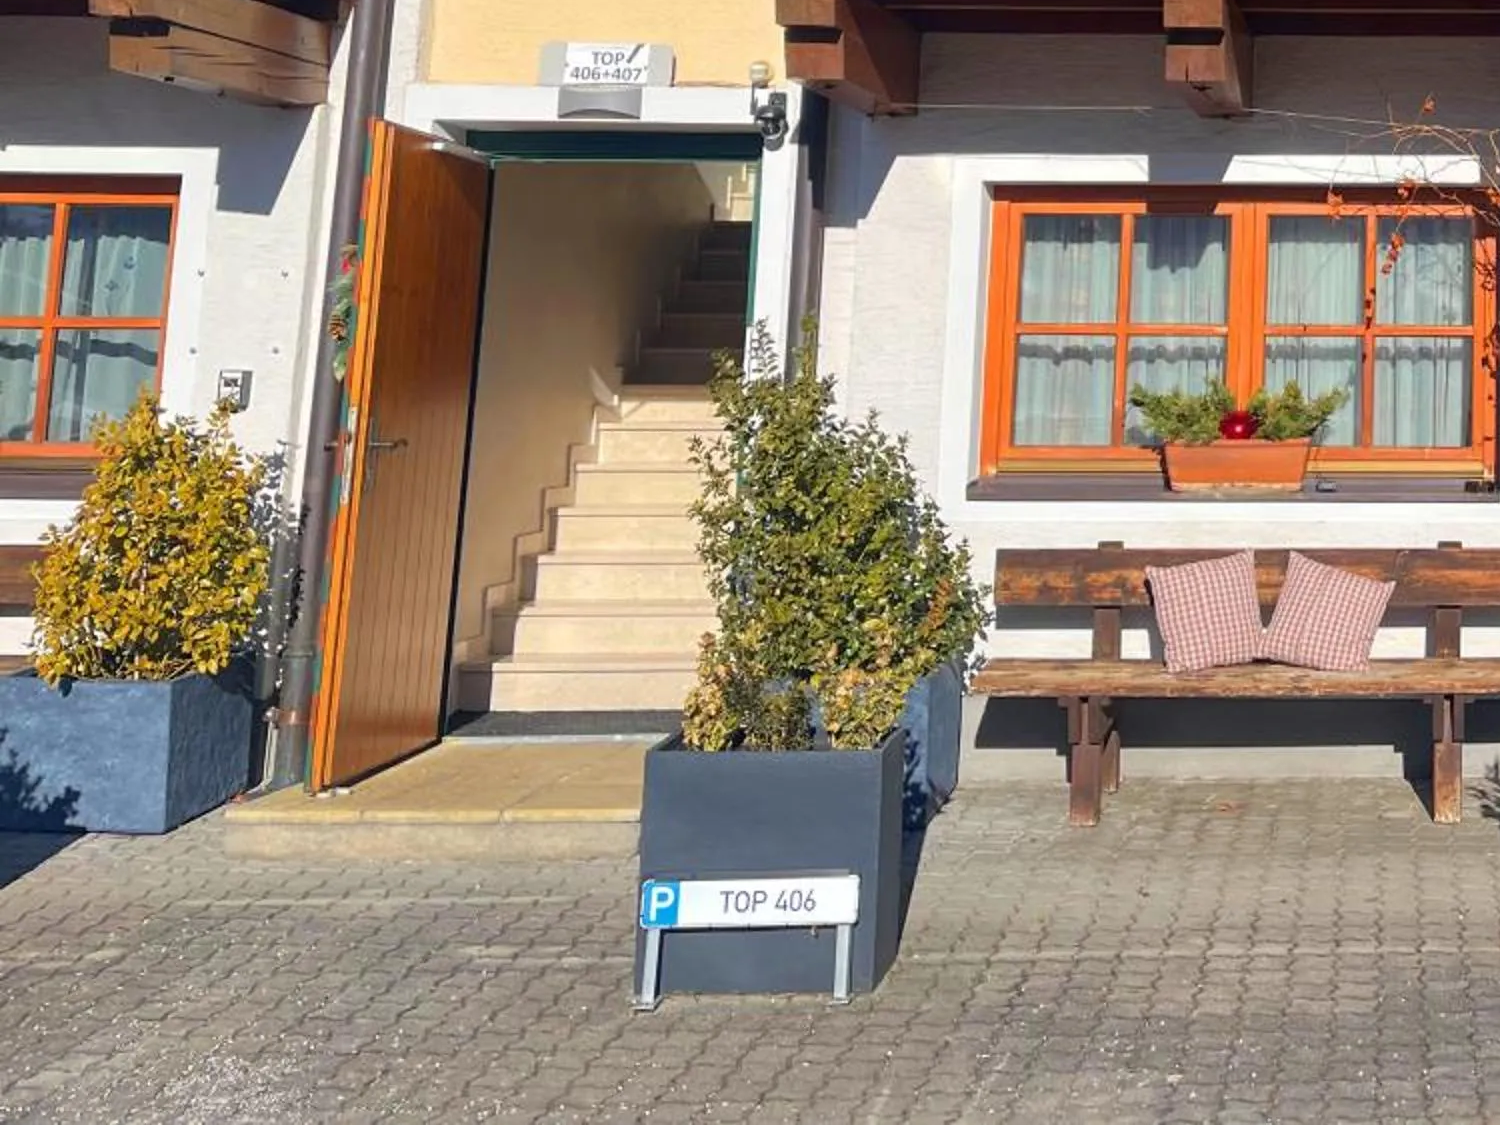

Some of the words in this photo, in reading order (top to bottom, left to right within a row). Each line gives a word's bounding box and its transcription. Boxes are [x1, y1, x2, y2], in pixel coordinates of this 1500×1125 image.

[592, 50, 626, 66] TOP
[570, 66, 642, 82] 406+407
[649, 886, 675, 922] P
[719, 889, 768, 914] TOP
[774, 888, 817, 912] 406
